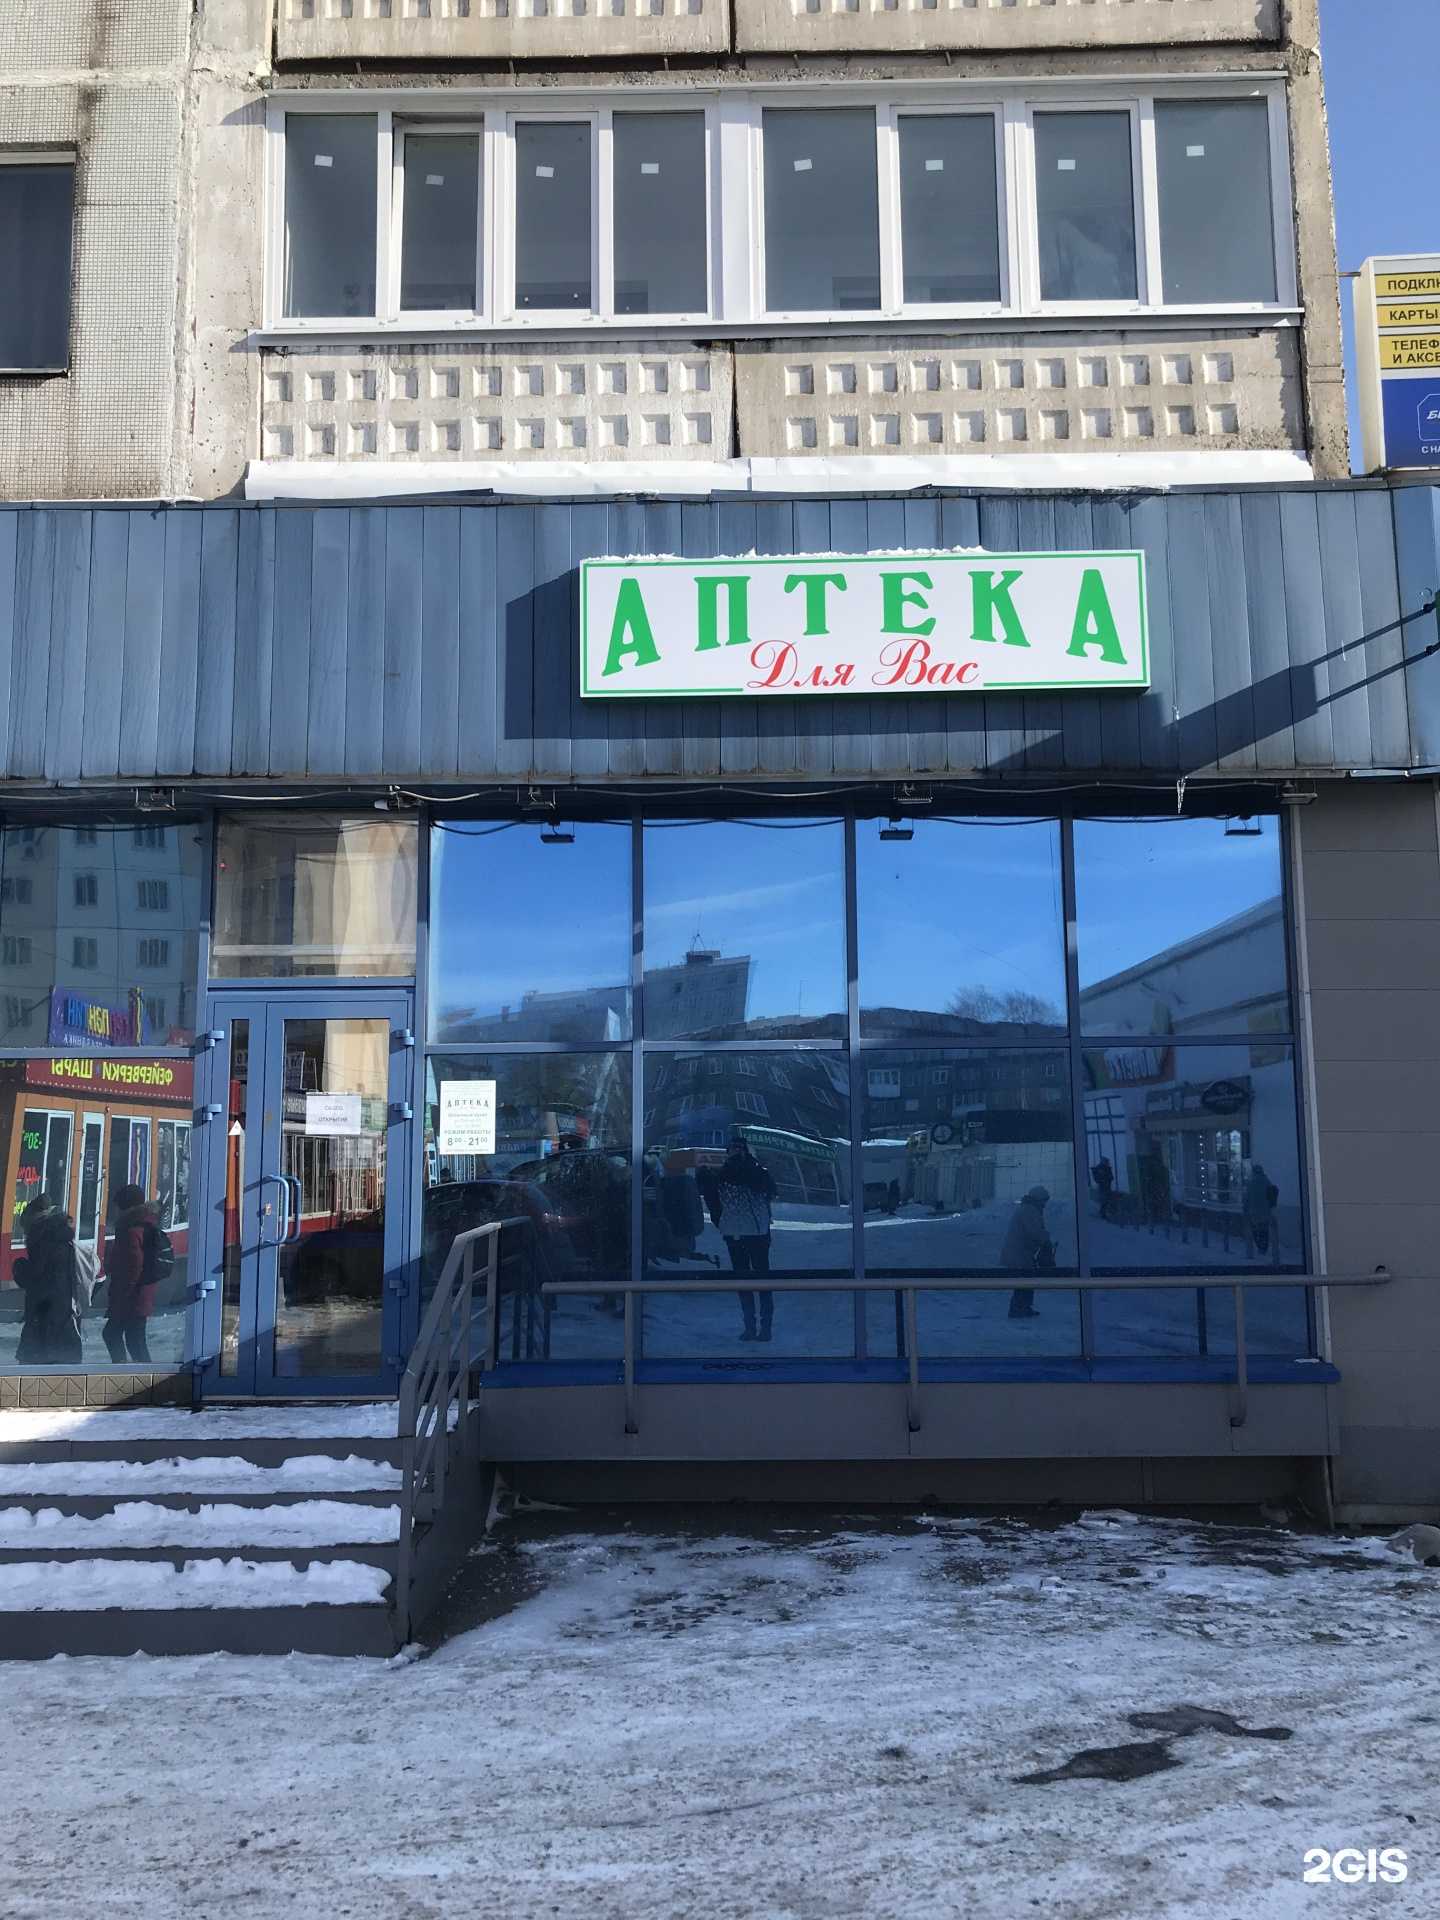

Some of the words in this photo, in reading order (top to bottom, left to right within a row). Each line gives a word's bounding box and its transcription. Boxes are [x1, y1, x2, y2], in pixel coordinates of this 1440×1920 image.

[1389, 309, 1438, 320] КАРТЫ
[1393, 354, 1402, 363] И
[1421, 446, 1429, 454] С
[602, 568, 1128, 676] АПТЕКА
[747, 640, 855, 688] Для
[871, 638, 979, 686] Вас
[448, 1099, 489, 1108] АПТЕКА
